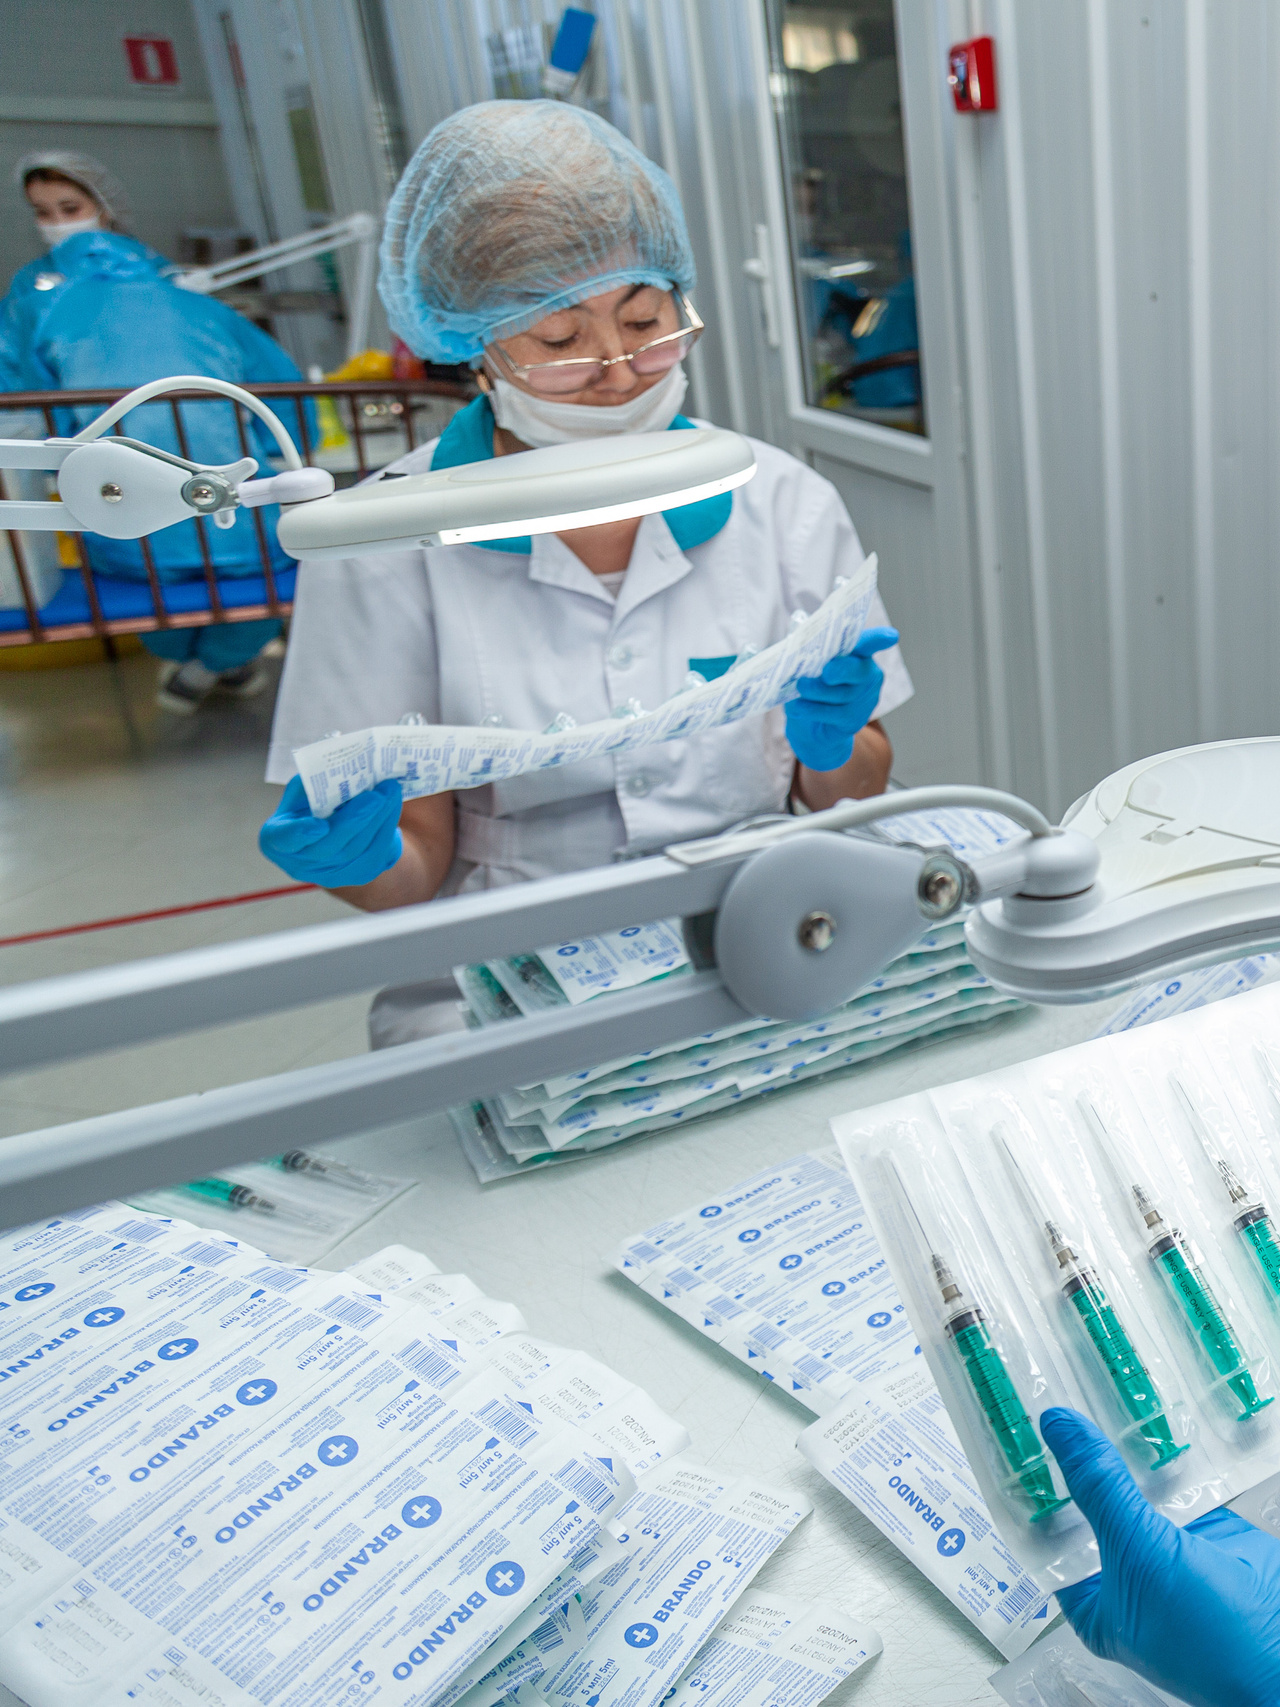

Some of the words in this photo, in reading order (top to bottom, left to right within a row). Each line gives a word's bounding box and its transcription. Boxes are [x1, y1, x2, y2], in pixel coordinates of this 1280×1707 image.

[724, 1175, 782, 1209] BRANDO
[763, 1197, 822, 1231] BRANDO
[805, 1221, 863, 1256] BRANDO
[1246, 1226, 1264, 1253] SINGLE
[1260, 1253, 1273, 1270] USE
[847, 1258, 886, 1285] BRAN
[1163, 1252, 1183, 1280] SINGLE
[1179, 1280, 1192, 1297] USE
[1188, 1297, 1204, 1319] ONLY
[333, 1332, 342, 1342] 5
[1086, 1326, 1099, 1343] USE
[1095, 1343, 1111, 1365] ONLY
[0, 1328, 81, 1382] BRAND
[46, 1356, 155, 1435] BRANDO
[412, 1391, 421, 1401] 5
[376, 1411, 396, 1430] 5ml
[621, 1413, 655, 1448] JAN2026
[832, 1413, 868, 1444] JAN2021
[127, 1400, 235, 1486] BRANDO
[492, 1449, 502, 1459] 5
[607, 1424, 640, 1455] JAN2021
[458, 1470, 478, 1489] 5ml
[213, 1459, 318, 1547] BRANDO
[886, 1473, 945, 1531] BRANDO
[572, 1514, 582, 1524] 5
[430, 1554, 444, 1567] MADE
[541, 1536, 560, 1555] 5ml
[300, 1520, 403, 1616] BRANDO
[399, 1569, 428, 1595] KAZAKHSTAN
[963, 1565, 979, 1581] 5ml
[652, 1556, 712, 1625] BRANDO
[986, 1587, 995, 1597] 5
[244, 1623, 259, 1637] FOR
[390, 1588, 487, 1684] BRANDO
[805, 1634, 845, 1654] JAN2021
[816, 1623, 857, 1645] JAN2026
[210, 1652, 225, 1666] USE
[516, 1649, 525, 1659] 5
[581, 1687, 590, 1697] 5
[598, 1656, 615, 1675] 5ml
